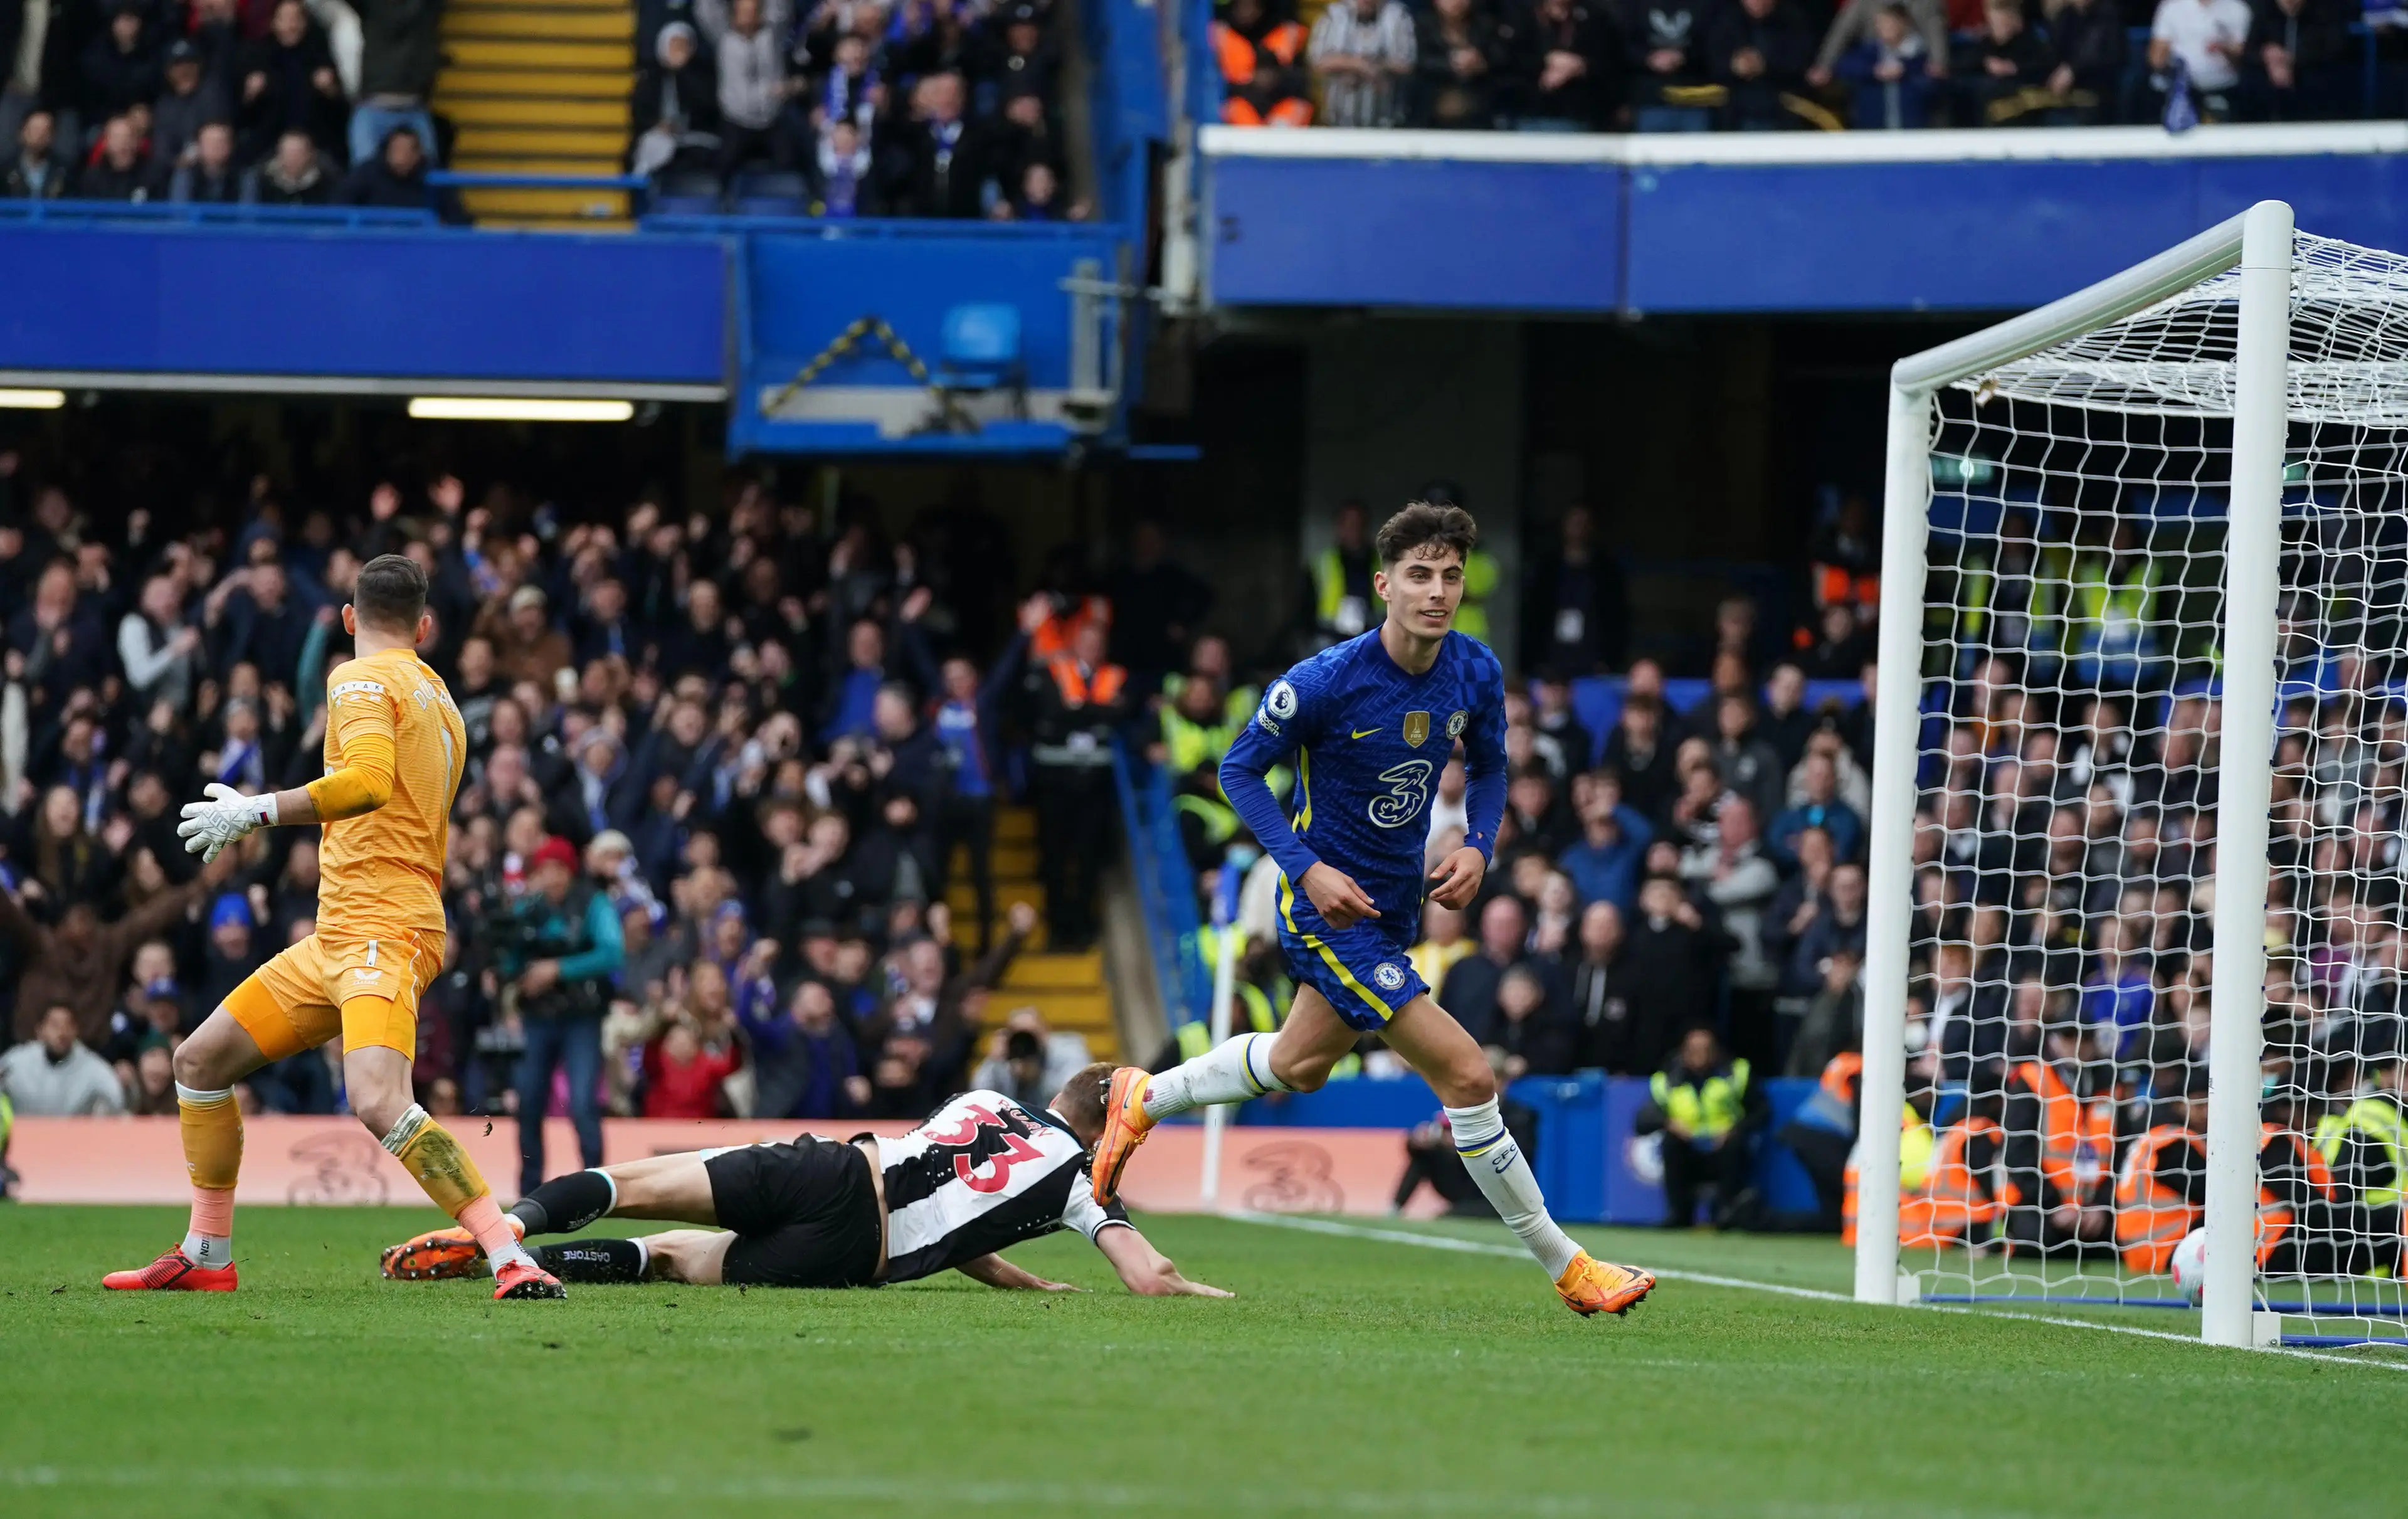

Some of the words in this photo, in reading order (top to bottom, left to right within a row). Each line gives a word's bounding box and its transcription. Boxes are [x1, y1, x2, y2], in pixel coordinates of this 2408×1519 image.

[332, 683, 380, 696] KAYAK
[1368, 759, 1433, 828] 3
[998, 1099, 1055, 1138] BURN
[919, 1104, 1046, 1194] 33
[1492, 1143, 1516, 1165] CFC
[562, 1250, 611, 1262] CASTORE
